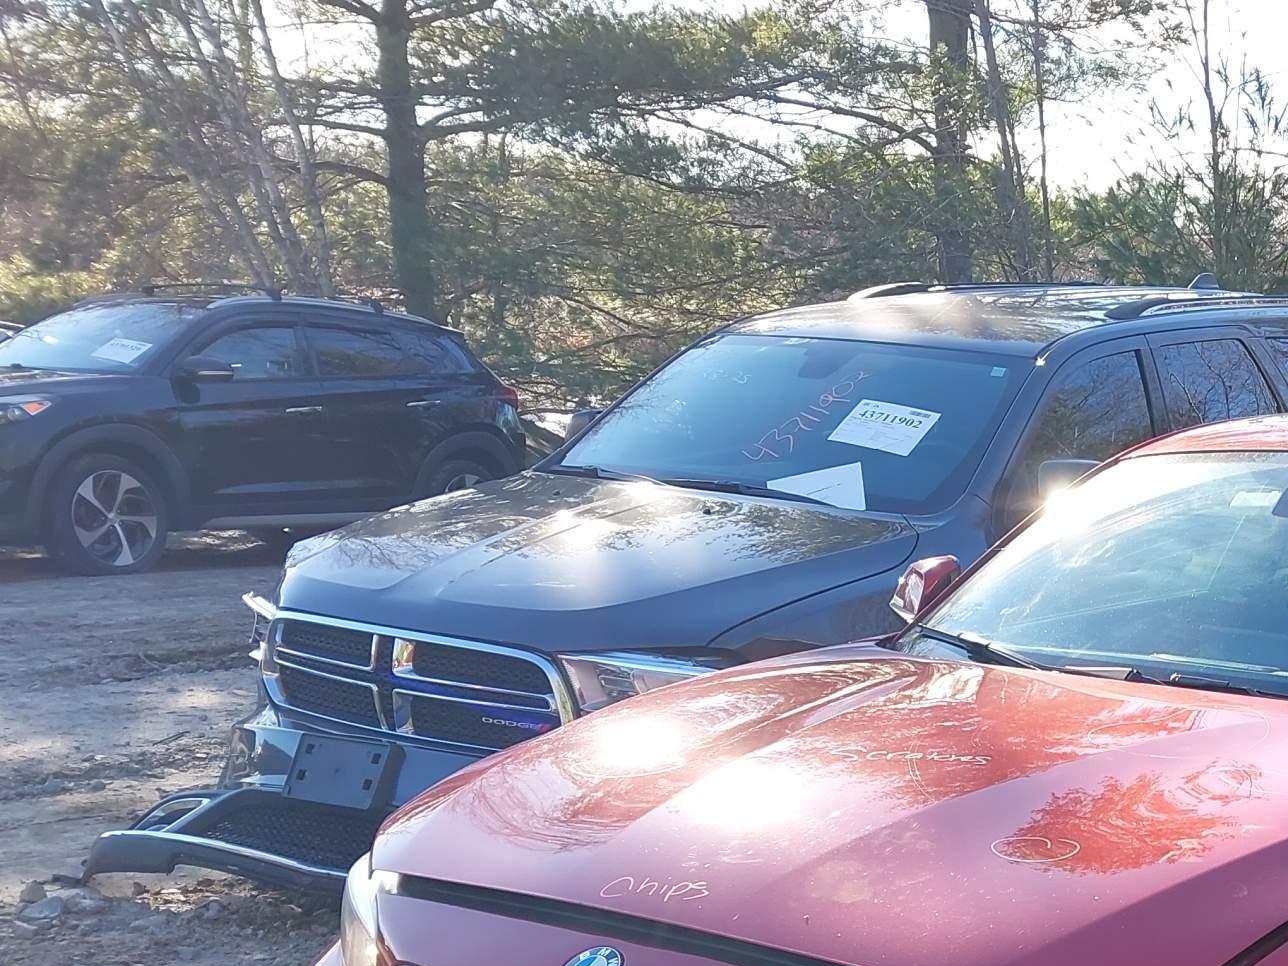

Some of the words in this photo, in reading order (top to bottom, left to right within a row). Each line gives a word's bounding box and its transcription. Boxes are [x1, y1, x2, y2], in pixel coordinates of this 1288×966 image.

[858, 410, 923, 429] 43711902
[481, 716, 537, 730] DODGE
[599, 876, 710, 902] Chips
[579, 947, 620, 966] BMW
